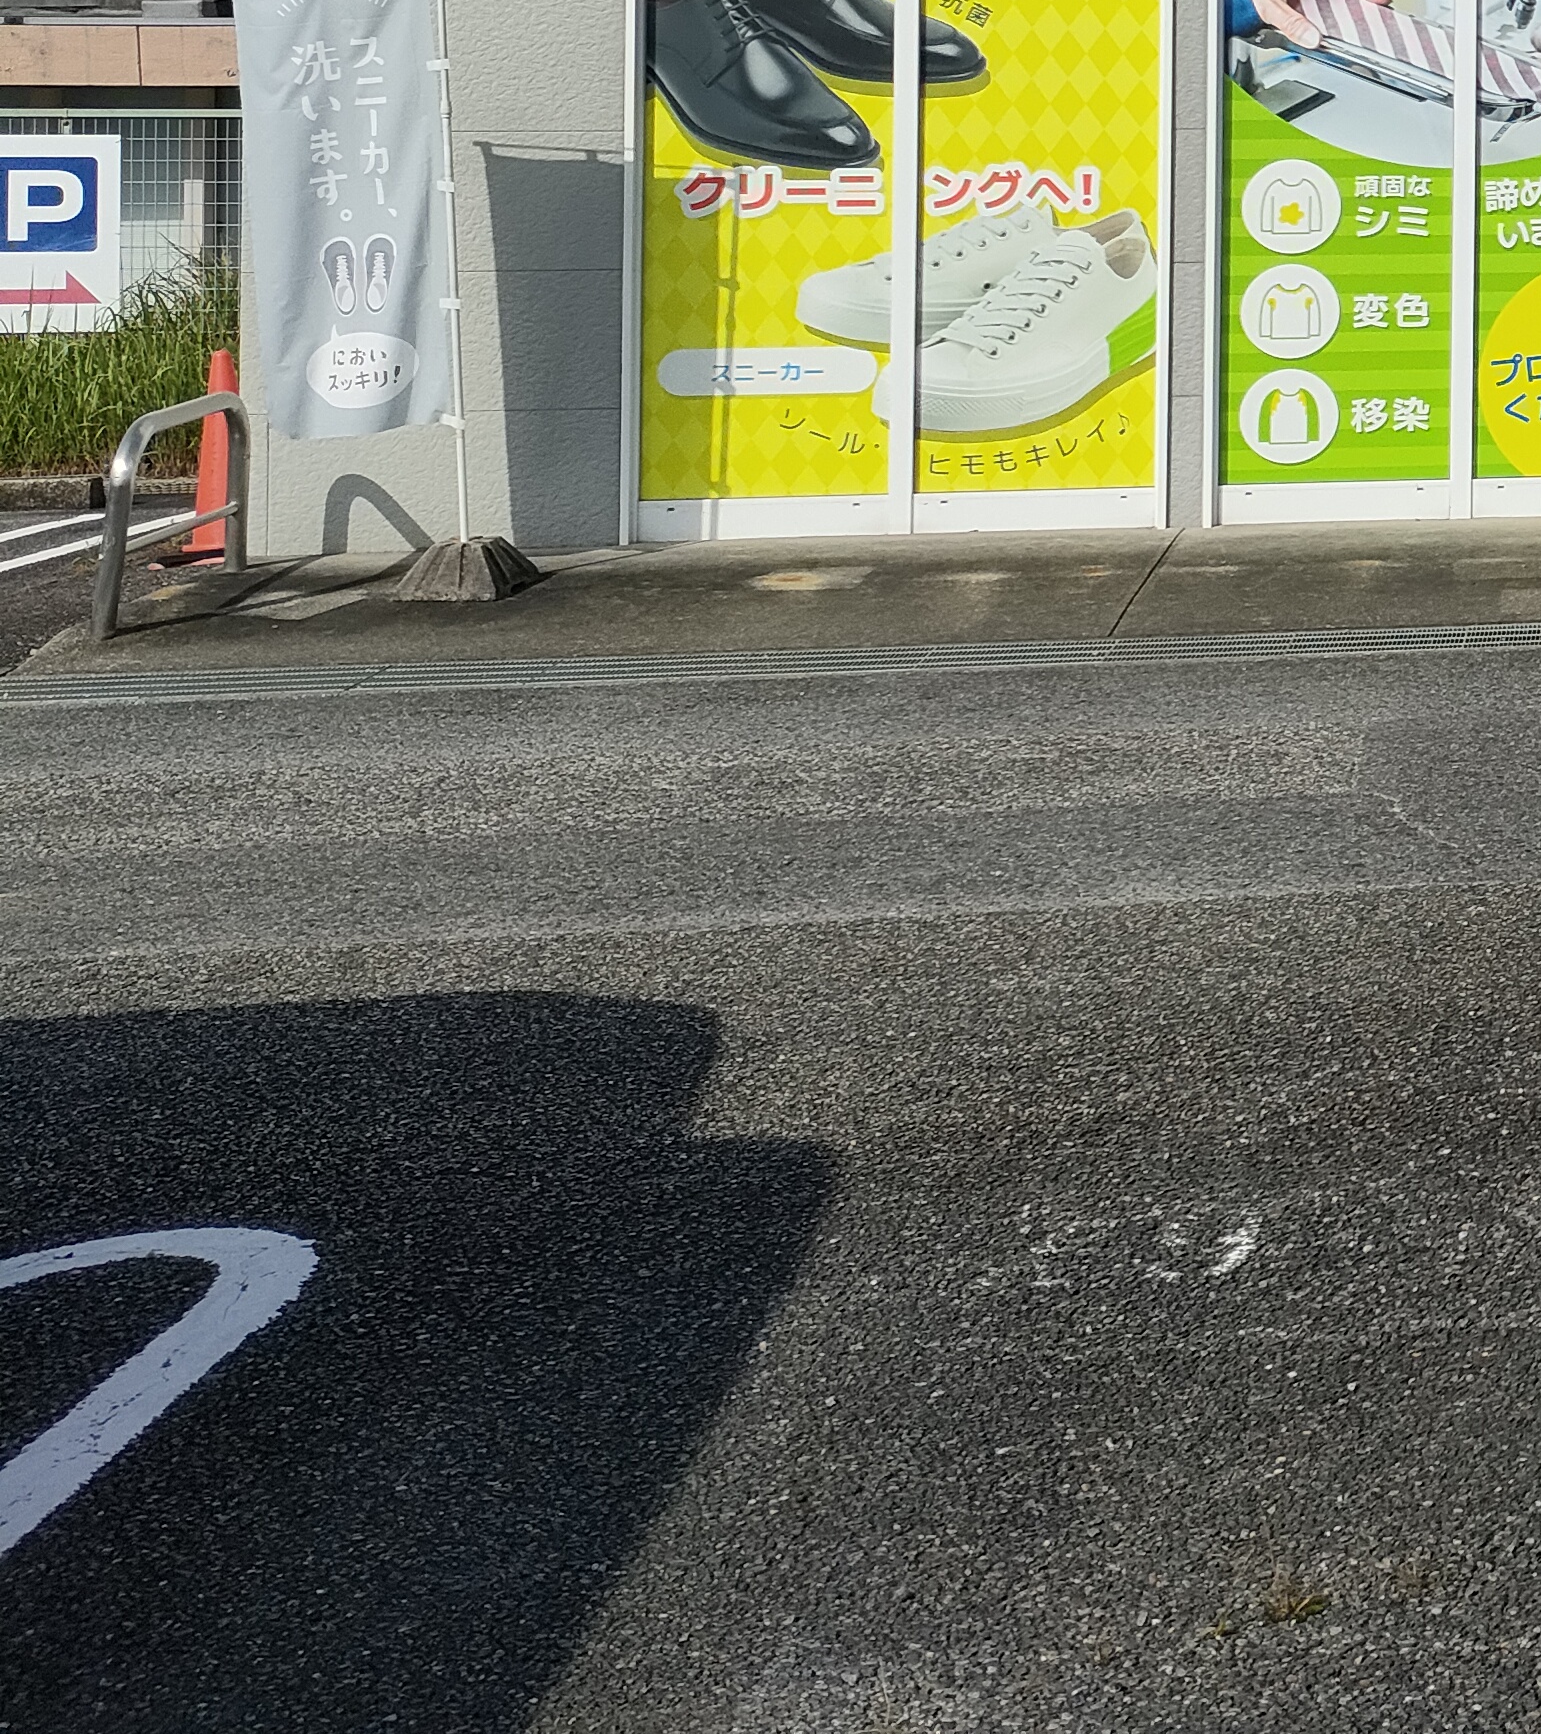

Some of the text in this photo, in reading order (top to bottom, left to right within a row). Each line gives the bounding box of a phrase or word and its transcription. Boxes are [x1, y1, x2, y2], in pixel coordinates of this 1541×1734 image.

[290, 40, 353, 222] 洗います。
[1354, 175, 1432, 198] 頑固な
[7, 169, 84, 242] P
[1355, 205, 1430, 237] シミ
[1352, 293, 1431, 329] 変色
[332, 347, 388, 366] におい
[711, 361, 824, 383] スニーカー
[328, 365, 401, 392] スッキリ!
[1350, 396, 1431, 434] 移染
